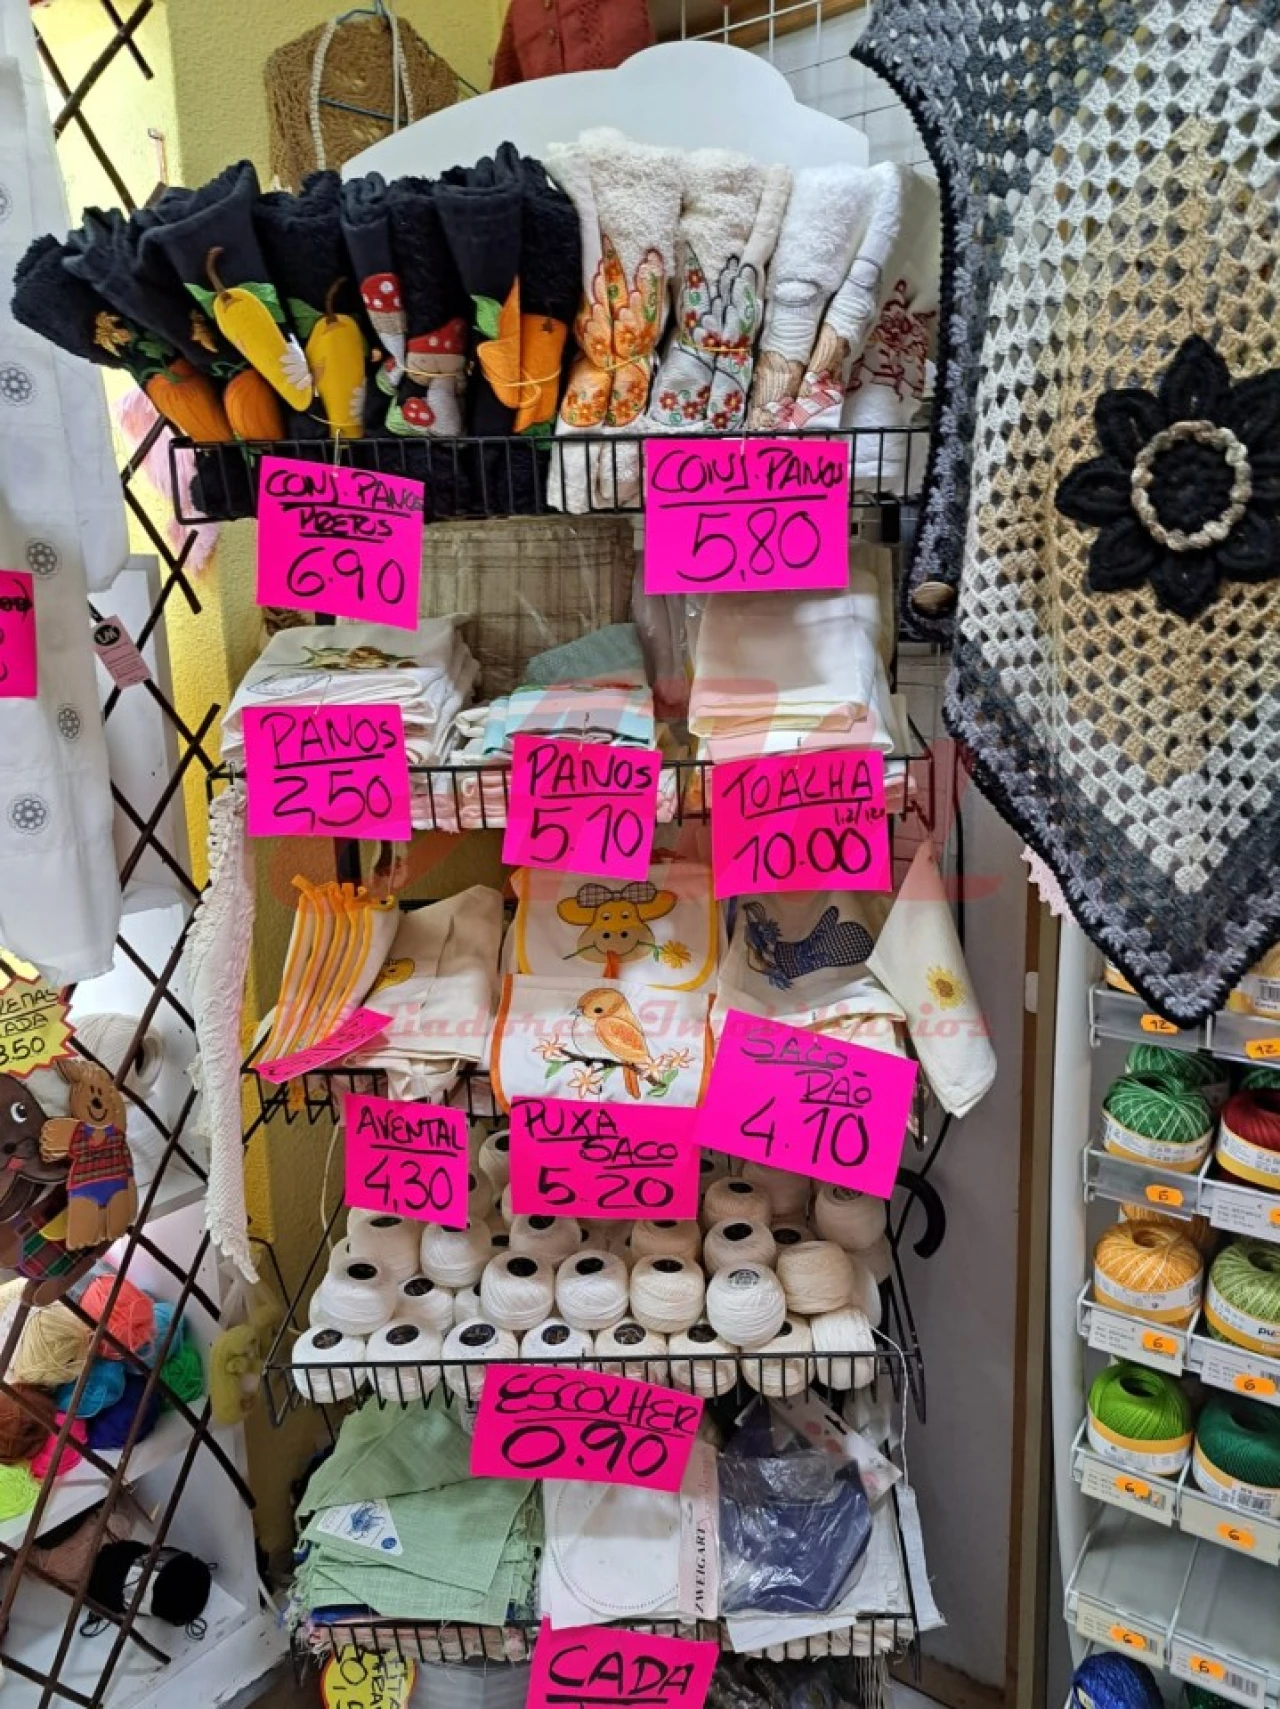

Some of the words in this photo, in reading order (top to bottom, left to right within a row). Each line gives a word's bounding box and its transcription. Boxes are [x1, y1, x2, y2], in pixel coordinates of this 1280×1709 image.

[677, 506, 821, 583] 5,80
[286, 546, 405, 605] 6.90
[259, 711, 397, 767] PANOS
[526, 743, 653, 797] PANOS
[721, 759, 874, 817] TOALHA
[273, 768, 393, 834] 2,50
[529, 802, 644, 864] 5.10
[732, 826, 872, 885] 10.00
[0, 1012, 48, 1038] ADA
[740, 1027, 849, 1070] SACO
[355, 1104, 466, 1151] AVENTAL
[511, 1098, 619, 1140] PUXA
[739, 1096, 870, 1168] 4.10
[578, 1136, 679, 1165] SACO
[363, 1154, 453, 1213] 4,30
[537, 1165, 675, 1210] 5.20
[1152, 1335, 1164, 1349] 6
[494, 1372, 699, 1436] ESCOLHER
[1243, 1378, 1256, 1391] 6
[501, 1420, 668, 1478] 0.90
[1124, 1481, 1135, 1494] 6
[1227, 1528, 1240, 1541] 6
[1122, 1632, 1133, 1645] 6
[548, 1644, 695, 1696] CADA
